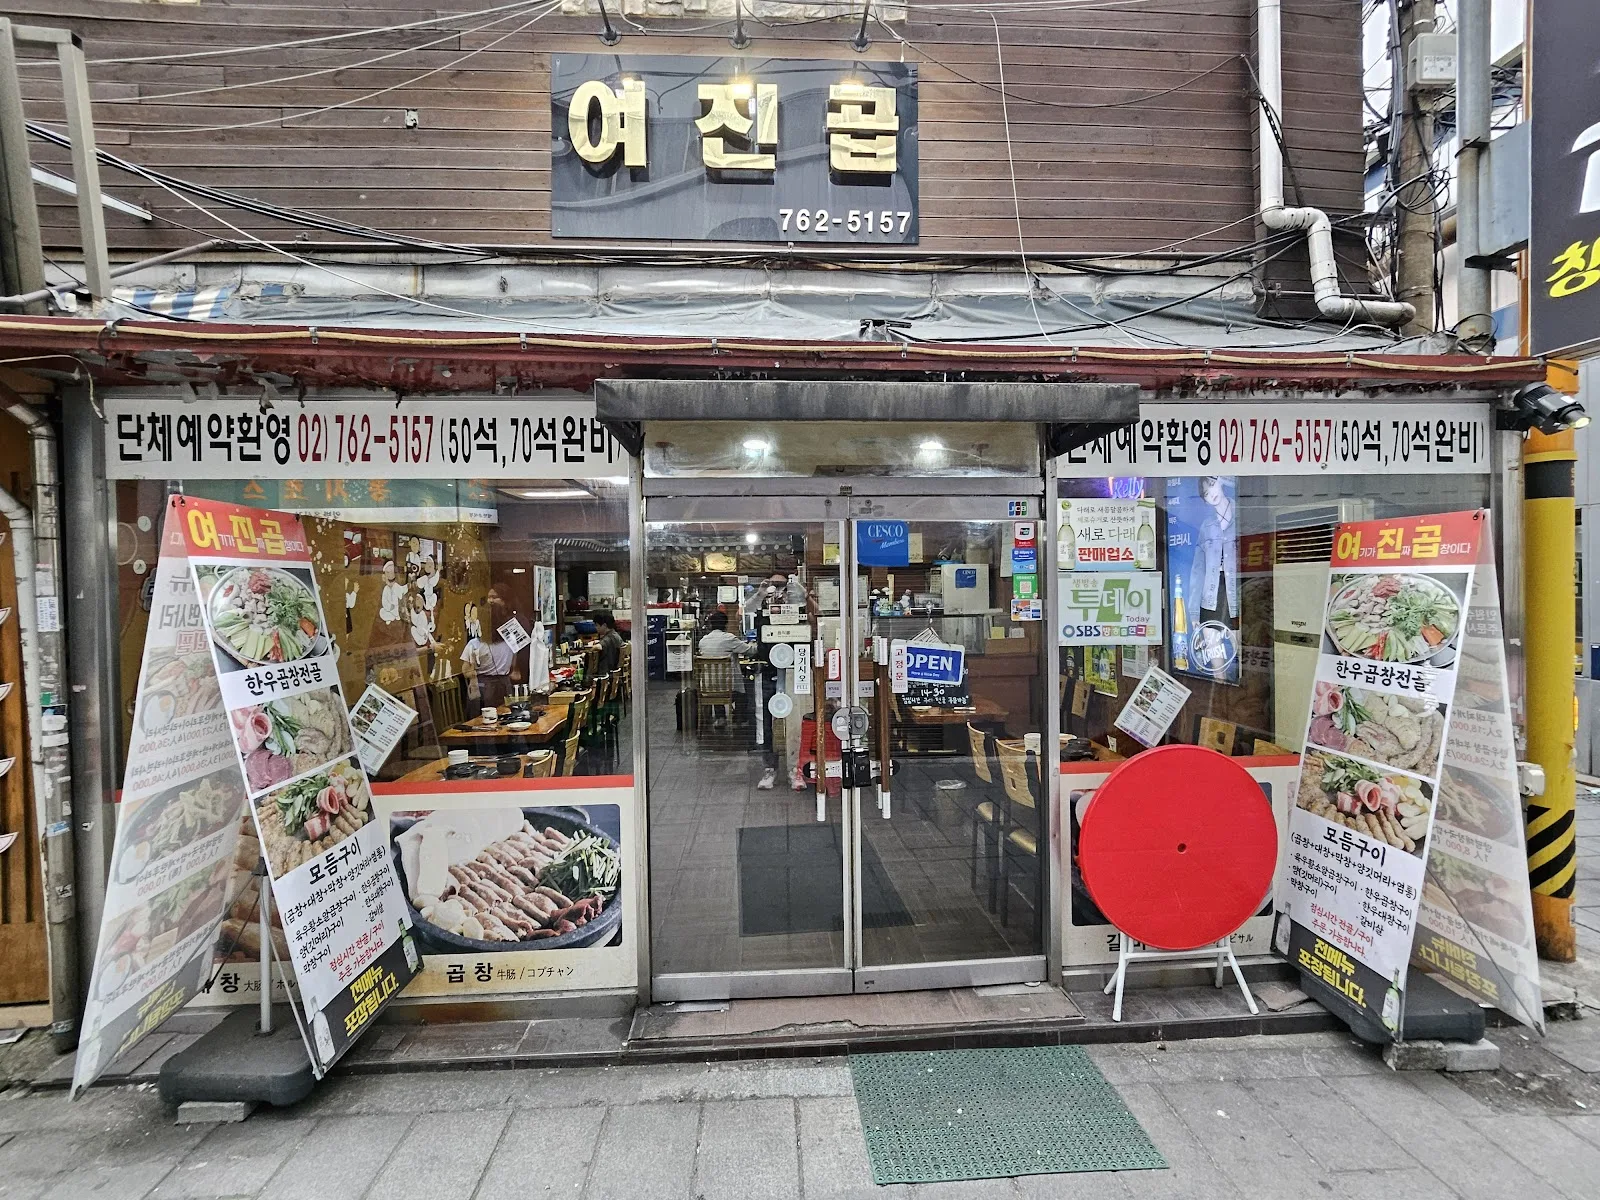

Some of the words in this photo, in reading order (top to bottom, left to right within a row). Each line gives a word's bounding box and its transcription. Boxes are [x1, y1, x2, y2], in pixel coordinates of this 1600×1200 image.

[780, 209, 911, 233] 762-5157
[117, 412, 290, 465] 단체예약환영
[1009, 502, 1027, 516] JCB
[868, 525, 904, 537] CESCO
[1077, 527, 1105, 542] 새로
[1108, 526, 1136, 542] 다래
[1337, 530, 1376, 560] 여기가
[1377, 527, 1411, 559] 진짜
[1412, 524, 1472, 558] 곱창이다
[1078, 547, 1134, 562] 판매업소
[1067, 588, 1151, 621] 투데이
[1126, 615, 1150, 623] Today
[1076, 625, 1100, 637] SBS
[245, 662, 323, 696] 한우곱창전골
[798, 648, 806, 681] 당기시오
[895, 649, 903, 680] 고정문
[309, 836, 362, 885] 모듬구이
[1323, 826, 1386, 867] 모듬구이
[1312, 918, 1328, 934] 주문
[528, 966, 574, 978] コプチャン
[1314, 938, 1355, 976] 전메뉴
[350, 966, 384, 1004] 전메뉴
[1298, 948, 1367, 1008] 포장됩니다.
[344, 972, 399, 1037] 포장됩니다.
